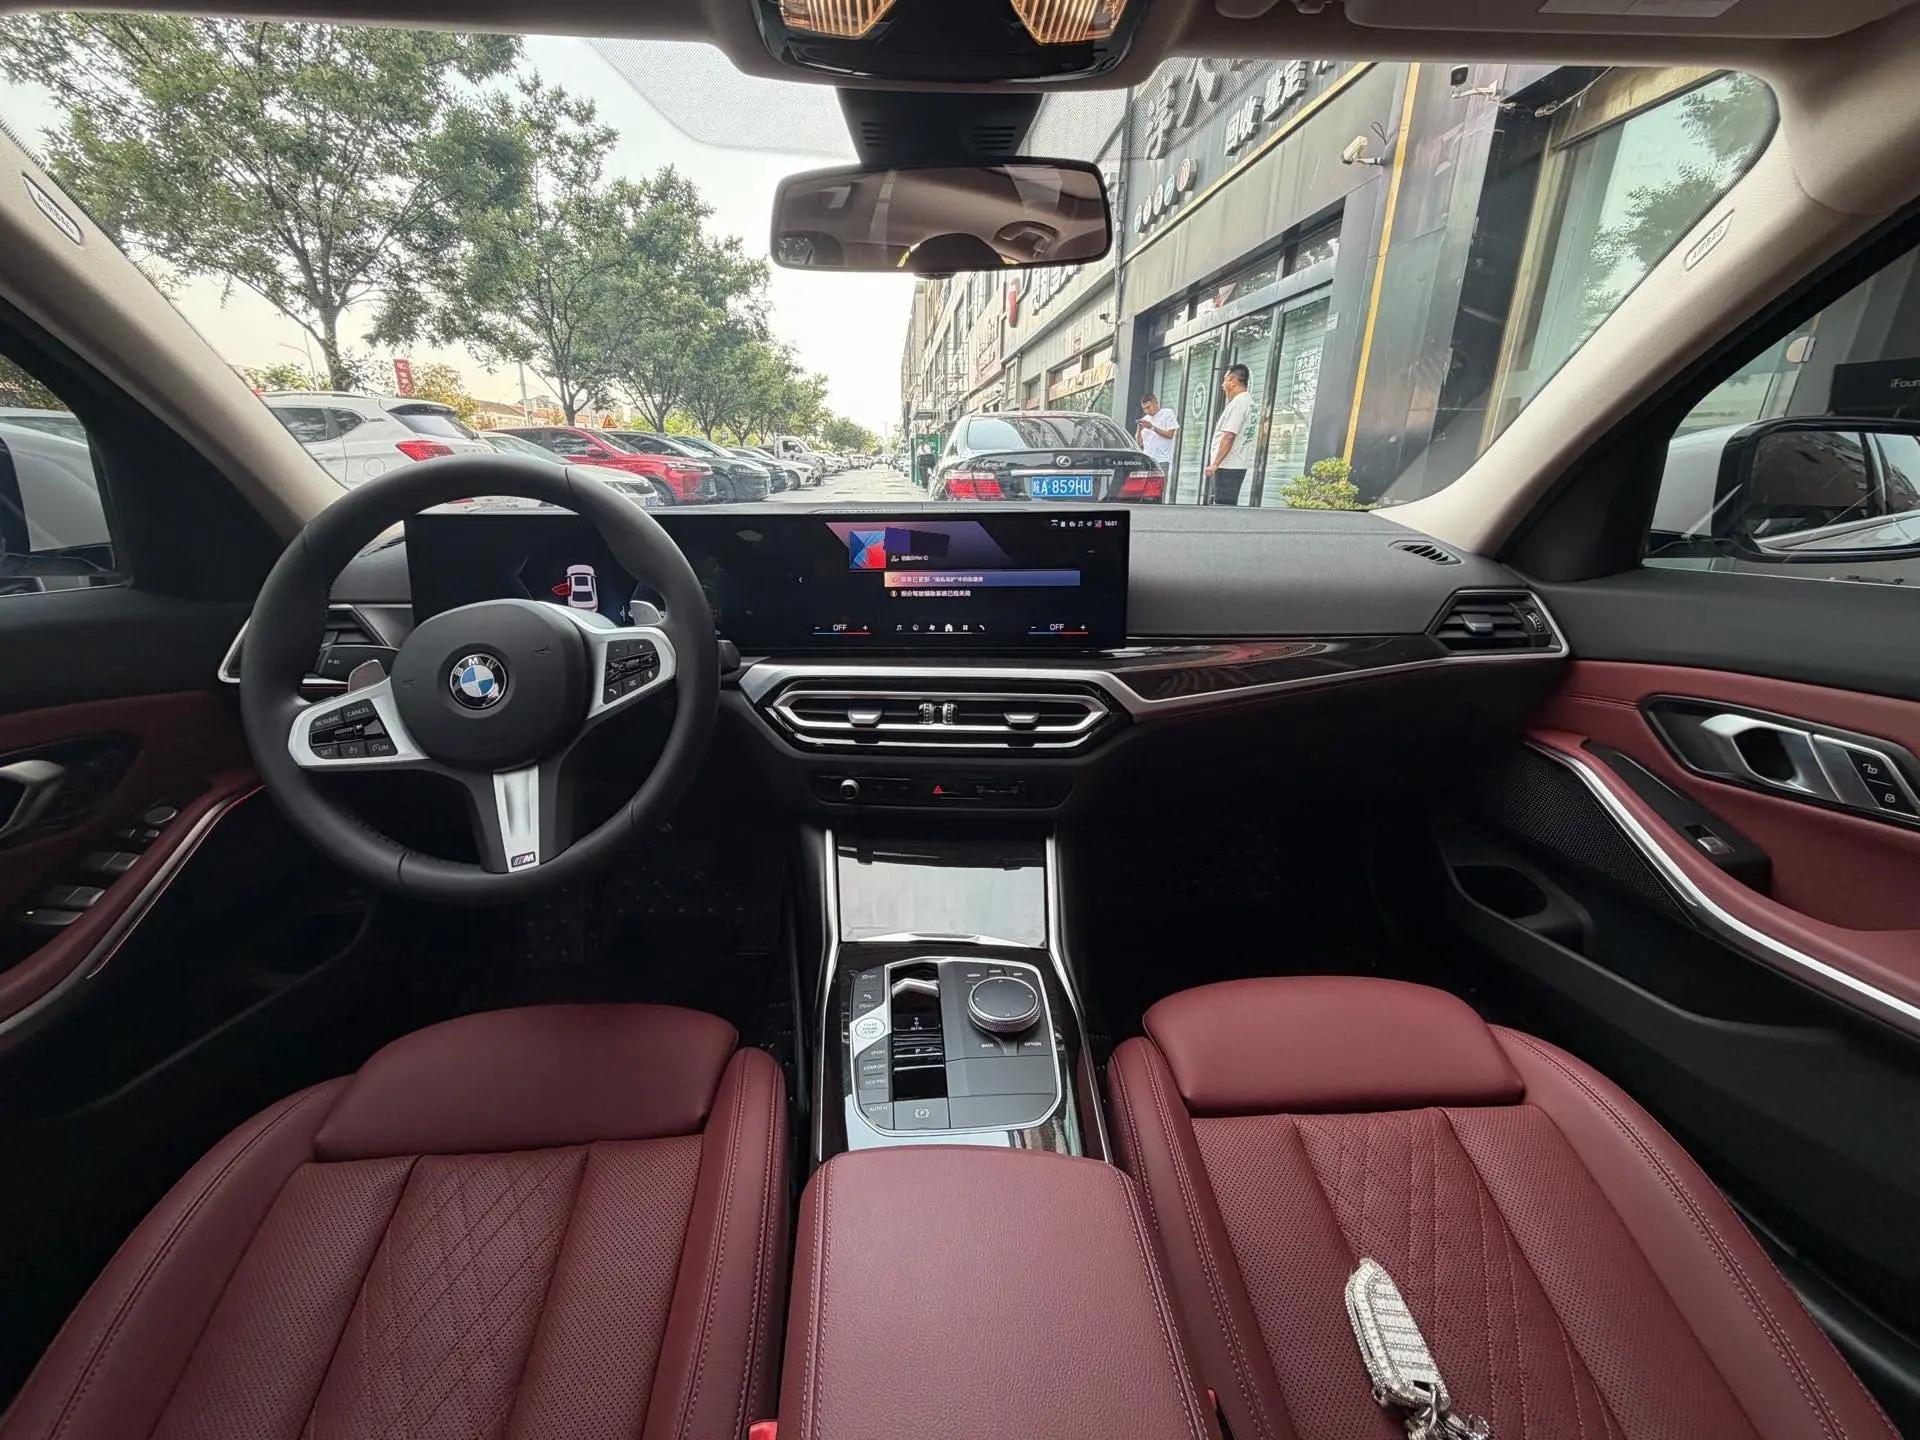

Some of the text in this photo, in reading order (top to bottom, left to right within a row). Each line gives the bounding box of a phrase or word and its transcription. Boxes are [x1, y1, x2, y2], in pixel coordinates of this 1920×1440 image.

[832, 623, 848, 631] OFF
[1049, 623, 1065, 631] OFF
[346, 706, 370, 718] CANCEL
[320, 748, 332, 756] SET
